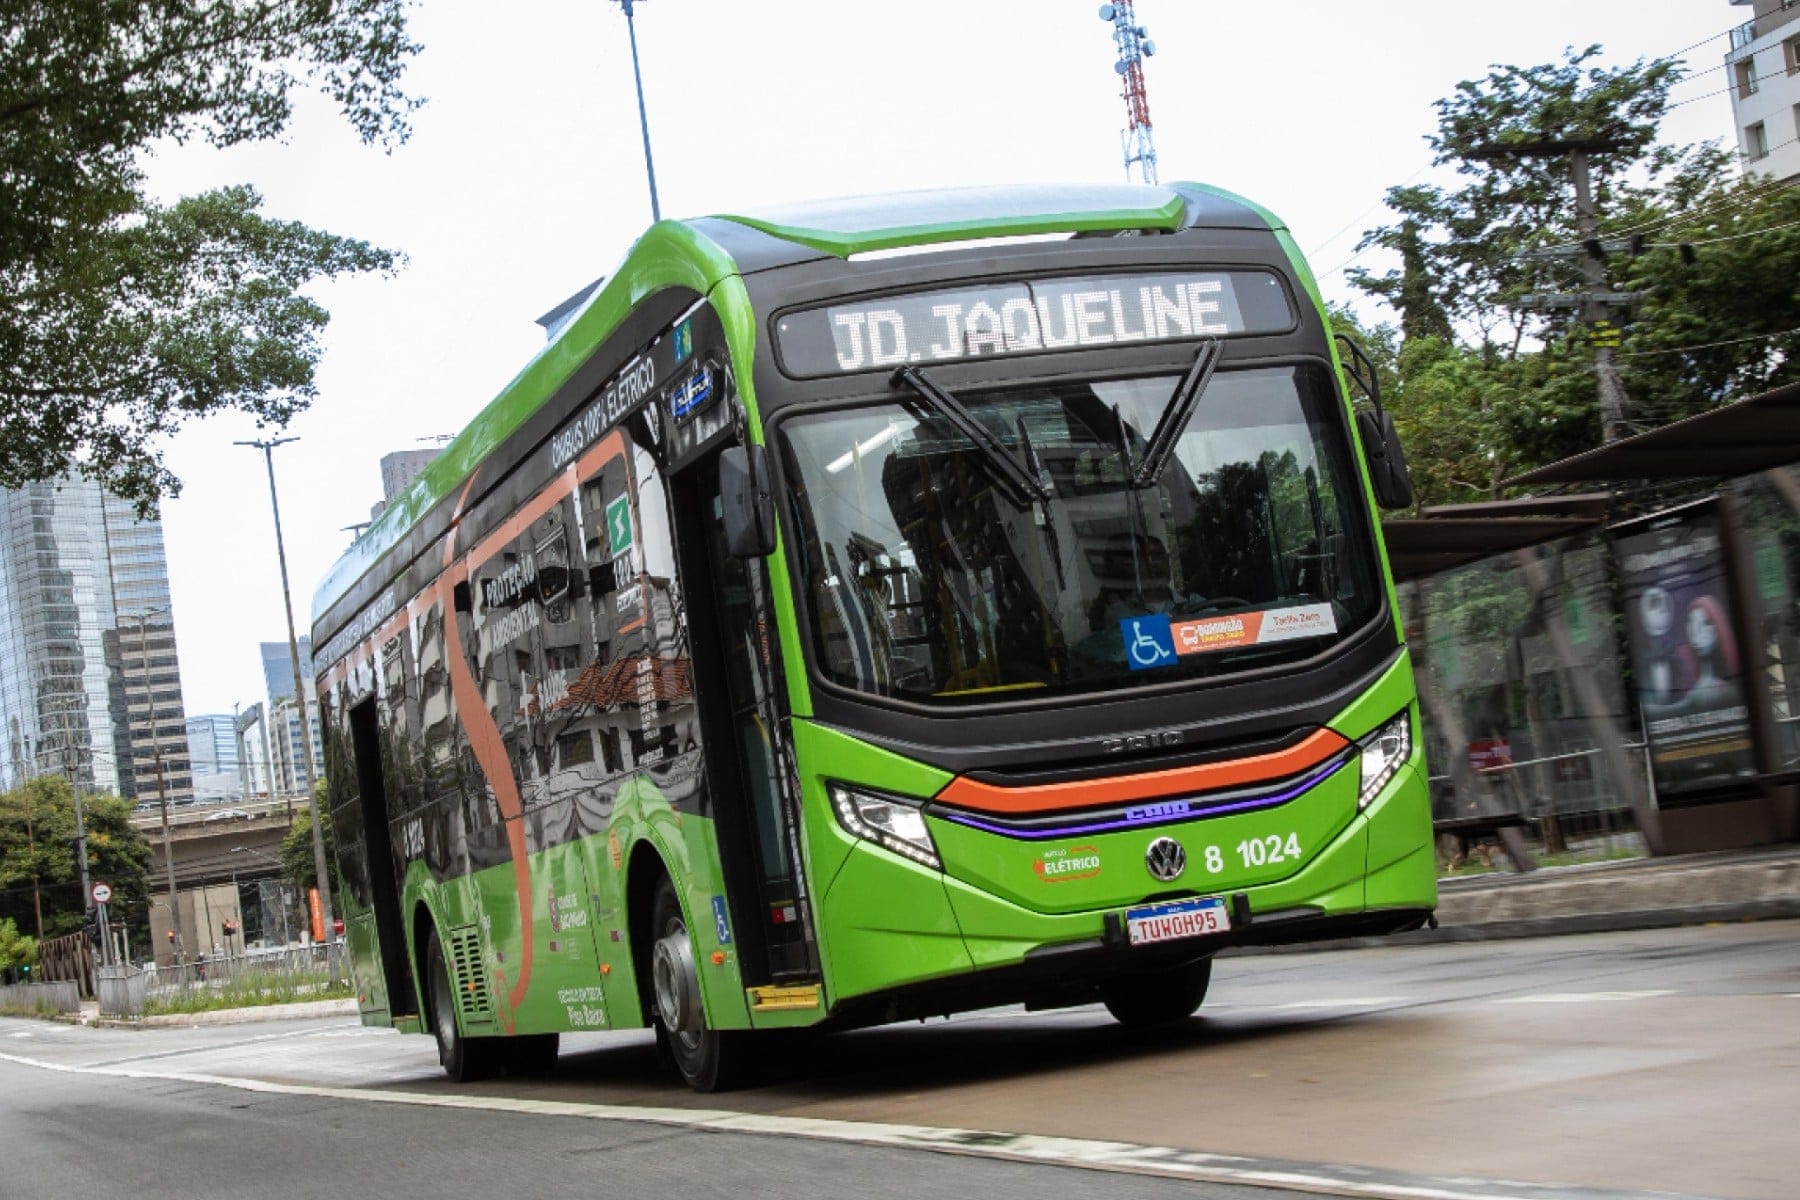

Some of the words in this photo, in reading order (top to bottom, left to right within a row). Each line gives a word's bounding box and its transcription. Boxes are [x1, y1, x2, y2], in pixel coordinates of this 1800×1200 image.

[835, 308, 921, 370] JD.
[932, 281, 1229, 356] JAQUELINE
[1044, 855, 1100, 875] ELÉTRICO
[1204, 845, 1223, 874] 8
[1236, 832, 1301, 868] 1024
